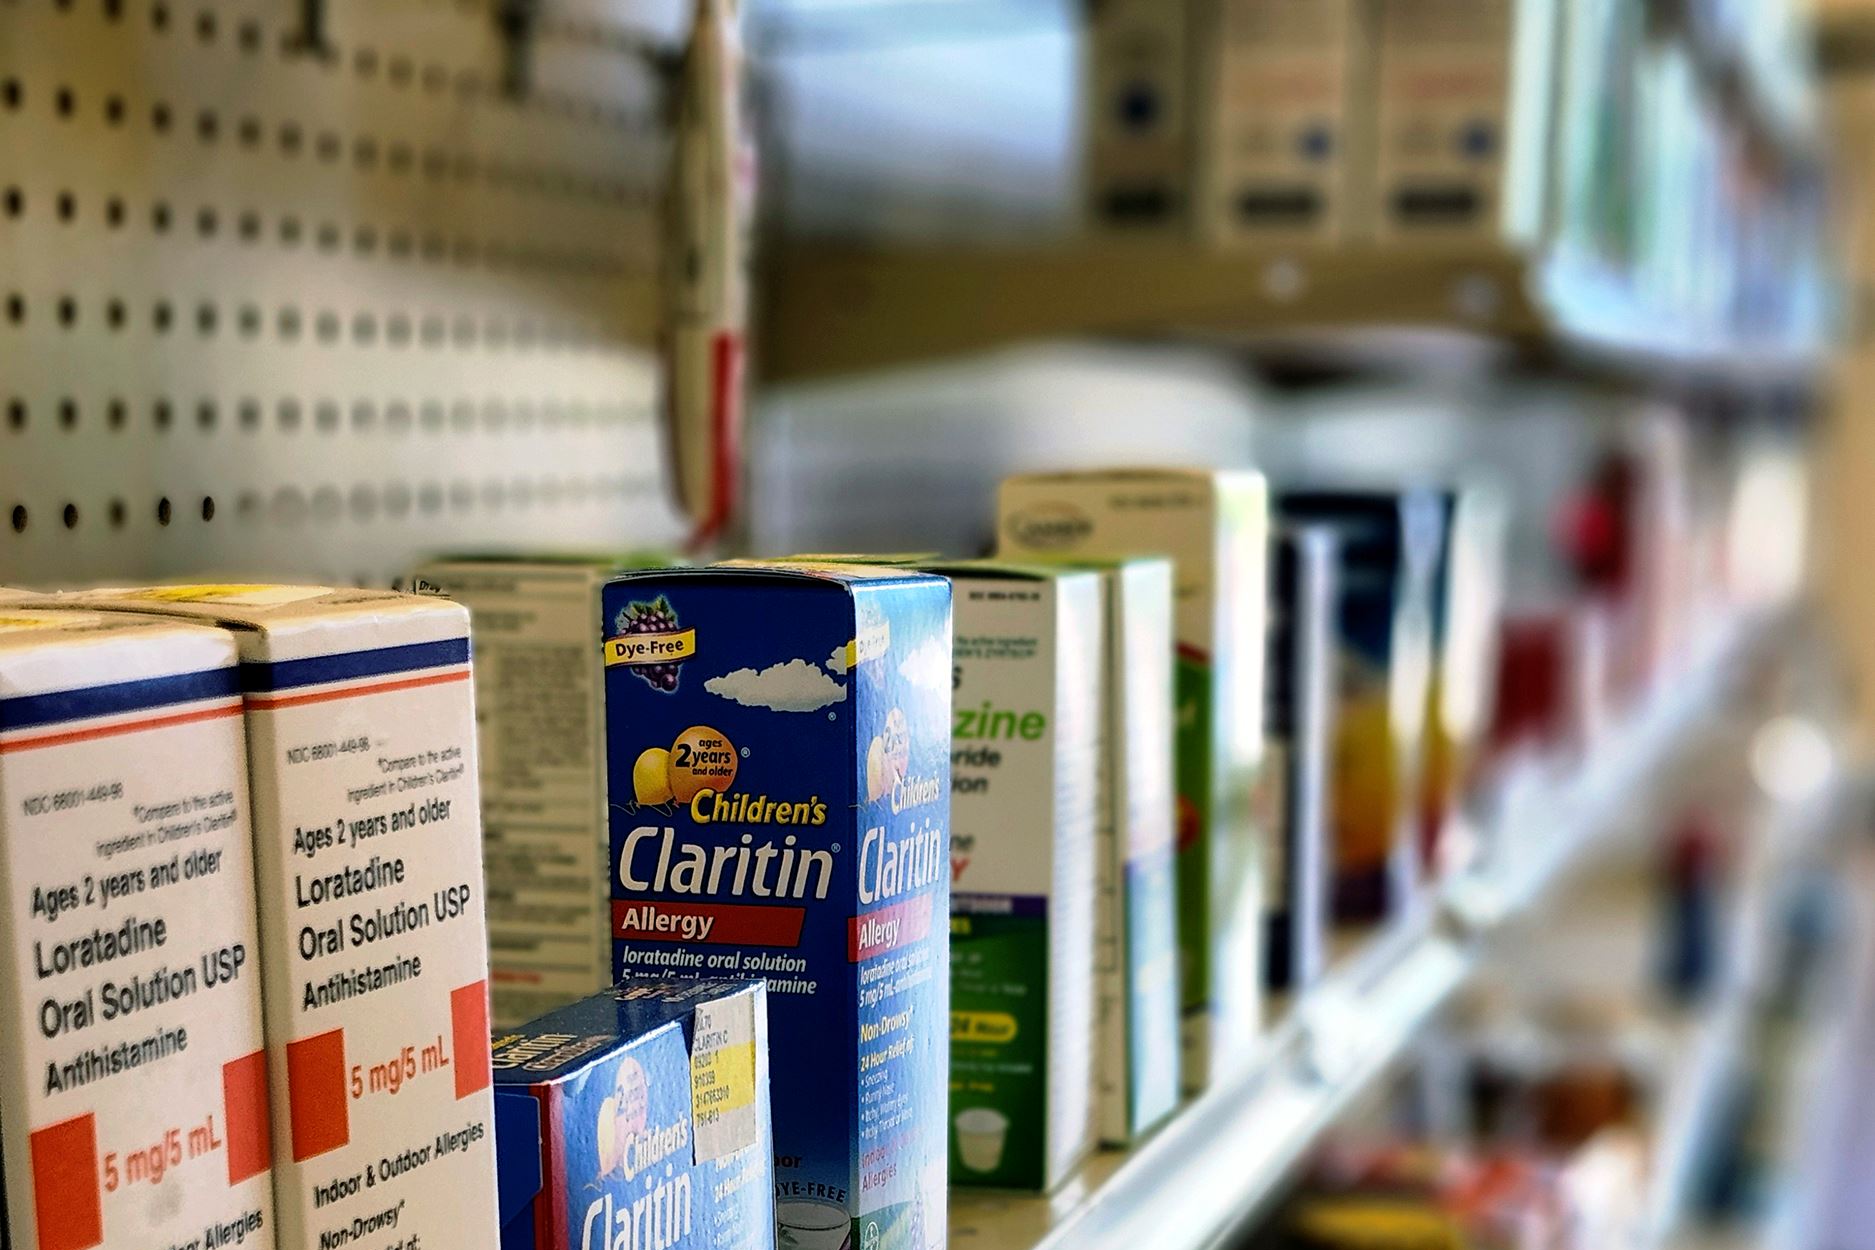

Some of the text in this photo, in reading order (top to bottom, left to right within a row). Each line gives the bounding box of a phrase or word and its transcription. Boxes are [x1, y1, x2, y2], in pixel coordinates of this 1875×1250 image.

[615, 637, 684, 656] Dye-Free
[675, 744, 731, 769] 2 years
[692, 766, 733, 777] and older
[699, 738, 722, 749] ages
[691, 789, 827, 825] Children's
[891, 773, 939, 814] Children's
[293, 797, 450, 858] Ages 2 years and older
[32, 848, 221, 921] Ages 2 years and older
[295, 857, 404, 907] Loratadine
[619, 826, 833, 899] Claritin
[858, 816, 940, 903] Claritin
[34, 918, 165, 978] Loratadine
[298, 884, 470, 960] Oral Solution USP
[621, 908, 714, 942] Allergy
[860, 917, 899, 950] Allergy
[303, 956, 420, 1010] Antihistamine
[623, 946, 806, 972] loratadine oral solution
[39, 944, 245, 1038] Oral Solution USP
[46, 1028, 186, 1094] Antihistamine
[350, 1064, 363, 1099] 5
[369, 1046, 416, 1094] mg/5
[421, 1035, 449, 1073] mL
[103, 1114, 221, 1192] 5 mg/5 mL
[313, 1122, 483, 1207] Indoor & Outdoor Allergies
[624, 1115, 688, 1182] Children's
